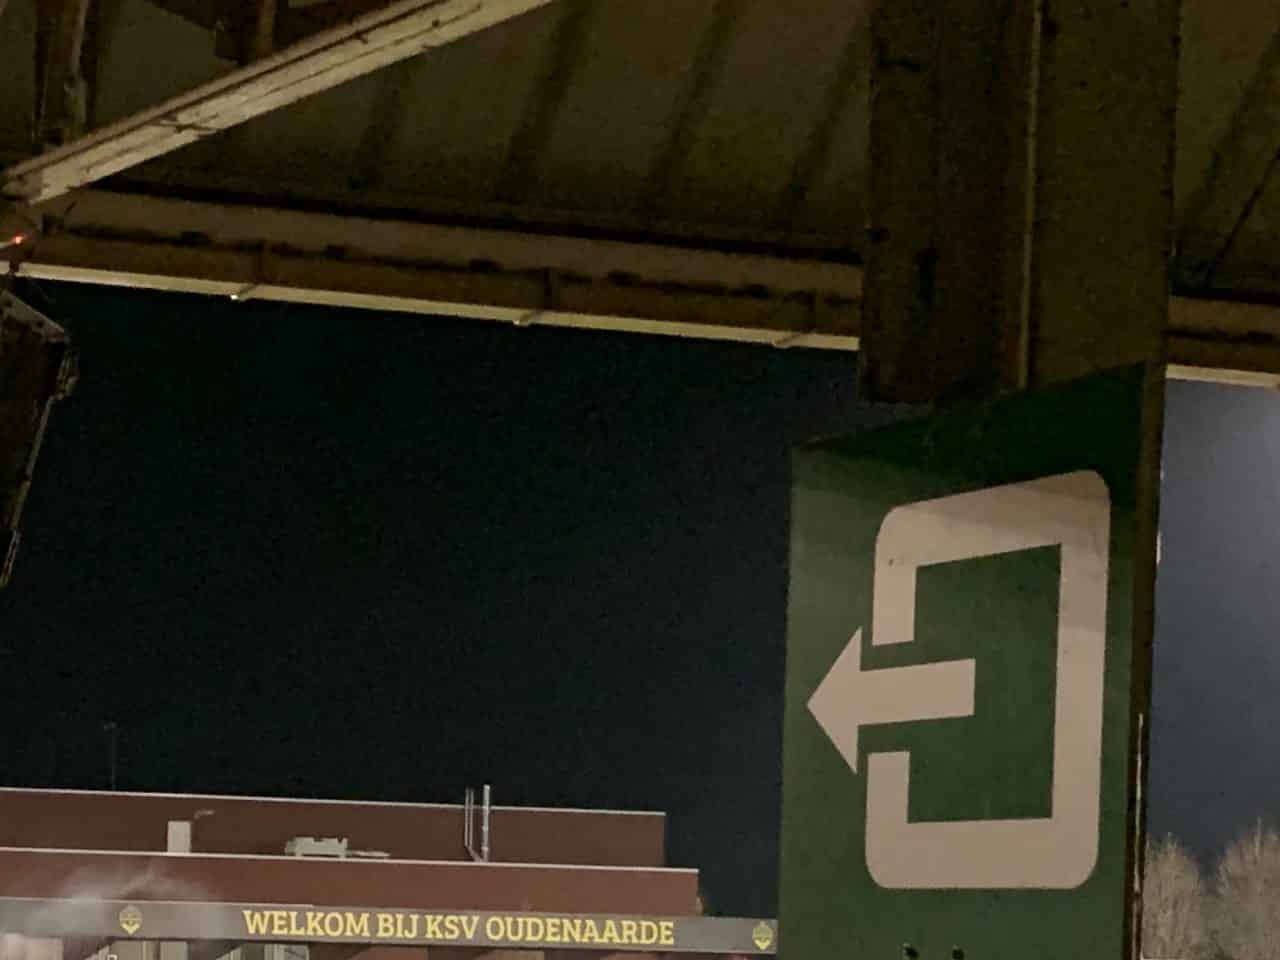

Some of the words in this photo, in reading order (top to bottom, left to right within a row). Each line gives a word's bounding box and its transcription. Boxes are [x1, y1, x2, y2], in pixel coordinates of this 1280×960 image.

[243, 909, 371, 938] WELKOM
[376, 912, 419, 939] BIJ
[425, 915, 479, 941] KSV
[485, 917, 674, 945] OUDENAARDE
